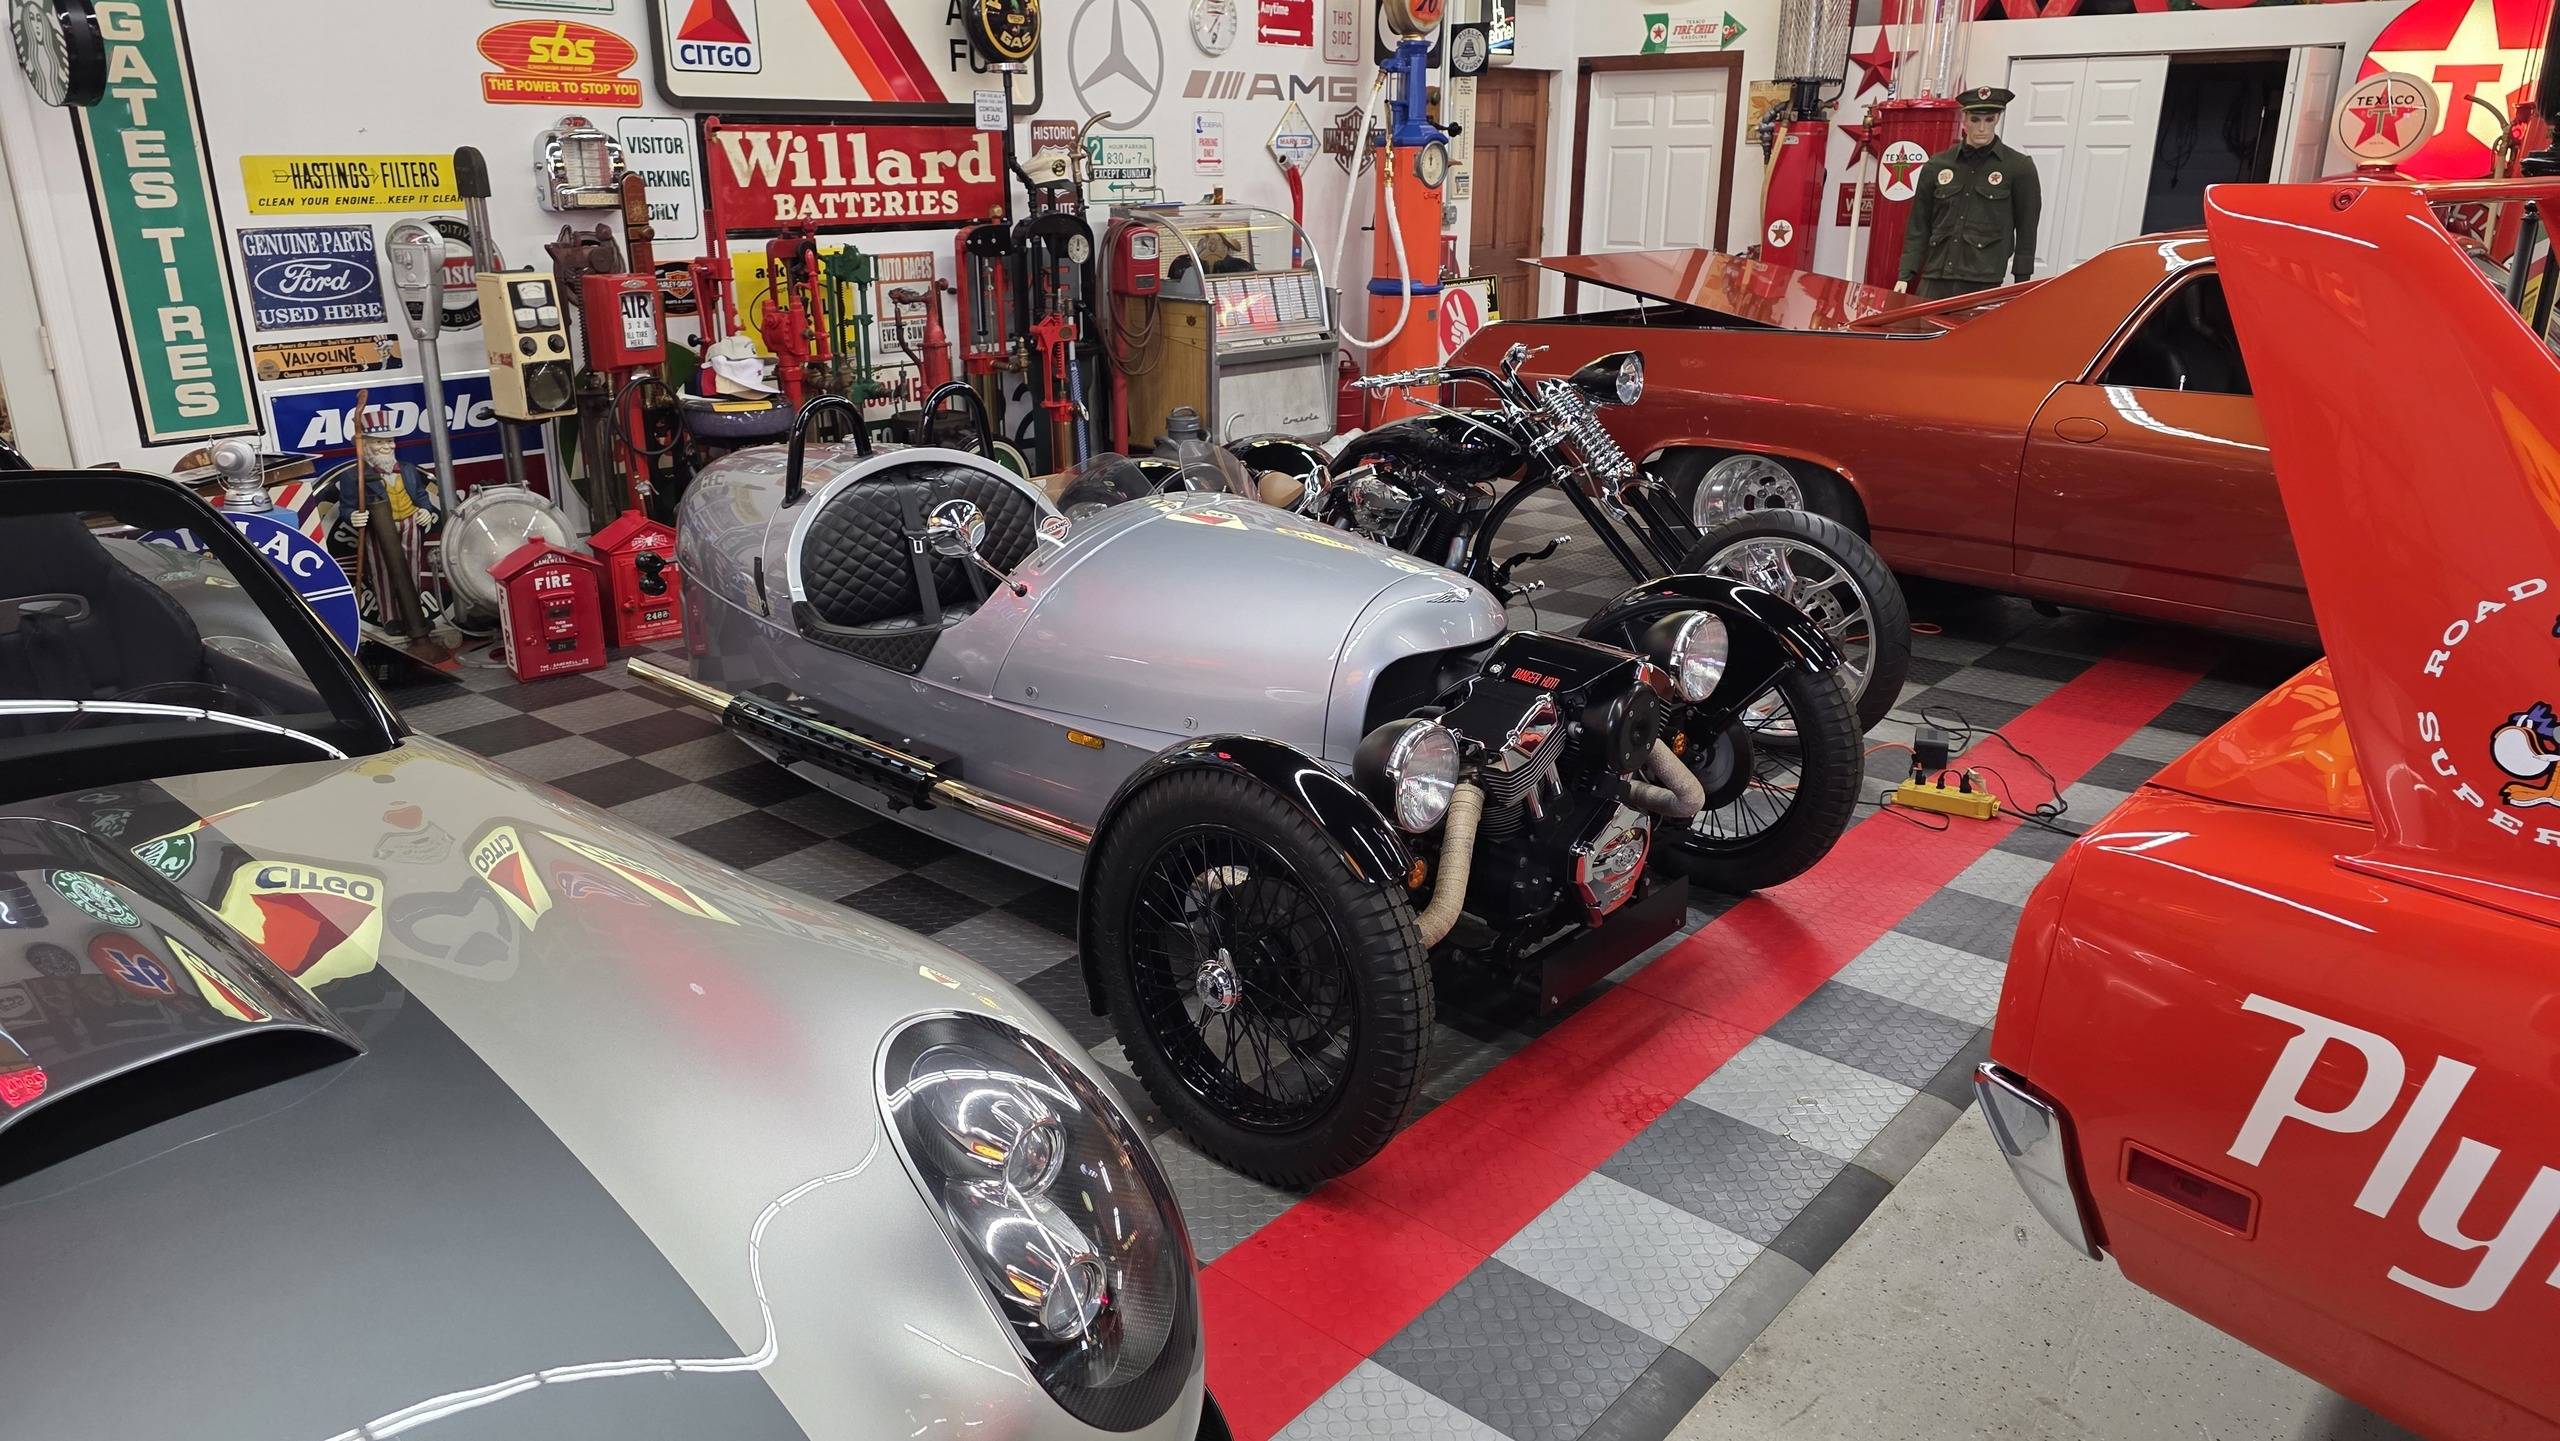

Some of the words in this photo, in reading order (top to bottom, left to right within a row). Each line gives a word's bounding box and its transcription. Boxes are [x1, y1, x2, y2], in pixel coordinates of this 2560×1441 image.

[1260, 1, 1289, 16] Anytime
[1333, 10, 1352, 26] THIS
[1000, 31, 1032, 48] GAS
[1332, 30, 1352, 45] SIDE
[1673, 24, 1719, 36] FIRE-CHIEF
[527, 24, 596, 65] sbs
[681, 44, 752, 67] CITGO
[488, 78, 515, 92] THE
[517, 80, 561, 93] POWER
[564, 81, 579, 94] TO
[581, 82, 612, 95] STOP
[613, 84, 638, 96] YOU
[1247, 73, 1358, 102] AMG
[95, 2, 178, 209] GATES
[2357, 95, 2415, 107] TEXACO
[1033, 126, 1076, 140] HISTORIC
[626, 136, 684, 155] VISITOR
[1090, 140, 1103, 164] 2
[1885, 152, 1923, 162] TEXACO
[714, 130, 997, 188] Willard
[290, 161, 371, 189] HASTINGS
[380, 161, 441, 188] FILTERS
[637, 170, 691, 188] ARKING
[1094, 169, 1120, 179] EXCEPT
[1122, 168, 1149, 178] SUNDAY
[258, 197, 295, 207] CLEAN
[301, 196, 331, 206] YOUR
[418, 194, 429, 204] IT
[773, 189, 960, 221] BATTERIES
[242, 232, 320, 257] GENUINE
[321, 230, 374, 253] PARTS
[278, 263, 351, 293] Ford
[877, 258, 902, 280] AUTO
[902, 256, 932, 279] RACES
[258, 307, 319, 325] USED
[323, 302, 384, 321] HERE
[620, 294, 650, 319] AIR
[141, 227, 220, 418] TIRES
[280, 346, 358, 368] VALVOLINE
[534, 573, 572, 590] FIRE
[498, 588, 515, 667] FIRE
[2423, 578, 2548, 678] ROAD
[1511, 667, 1542, 684] DANGER
[2226, 993, 2560, 1312] Ply
